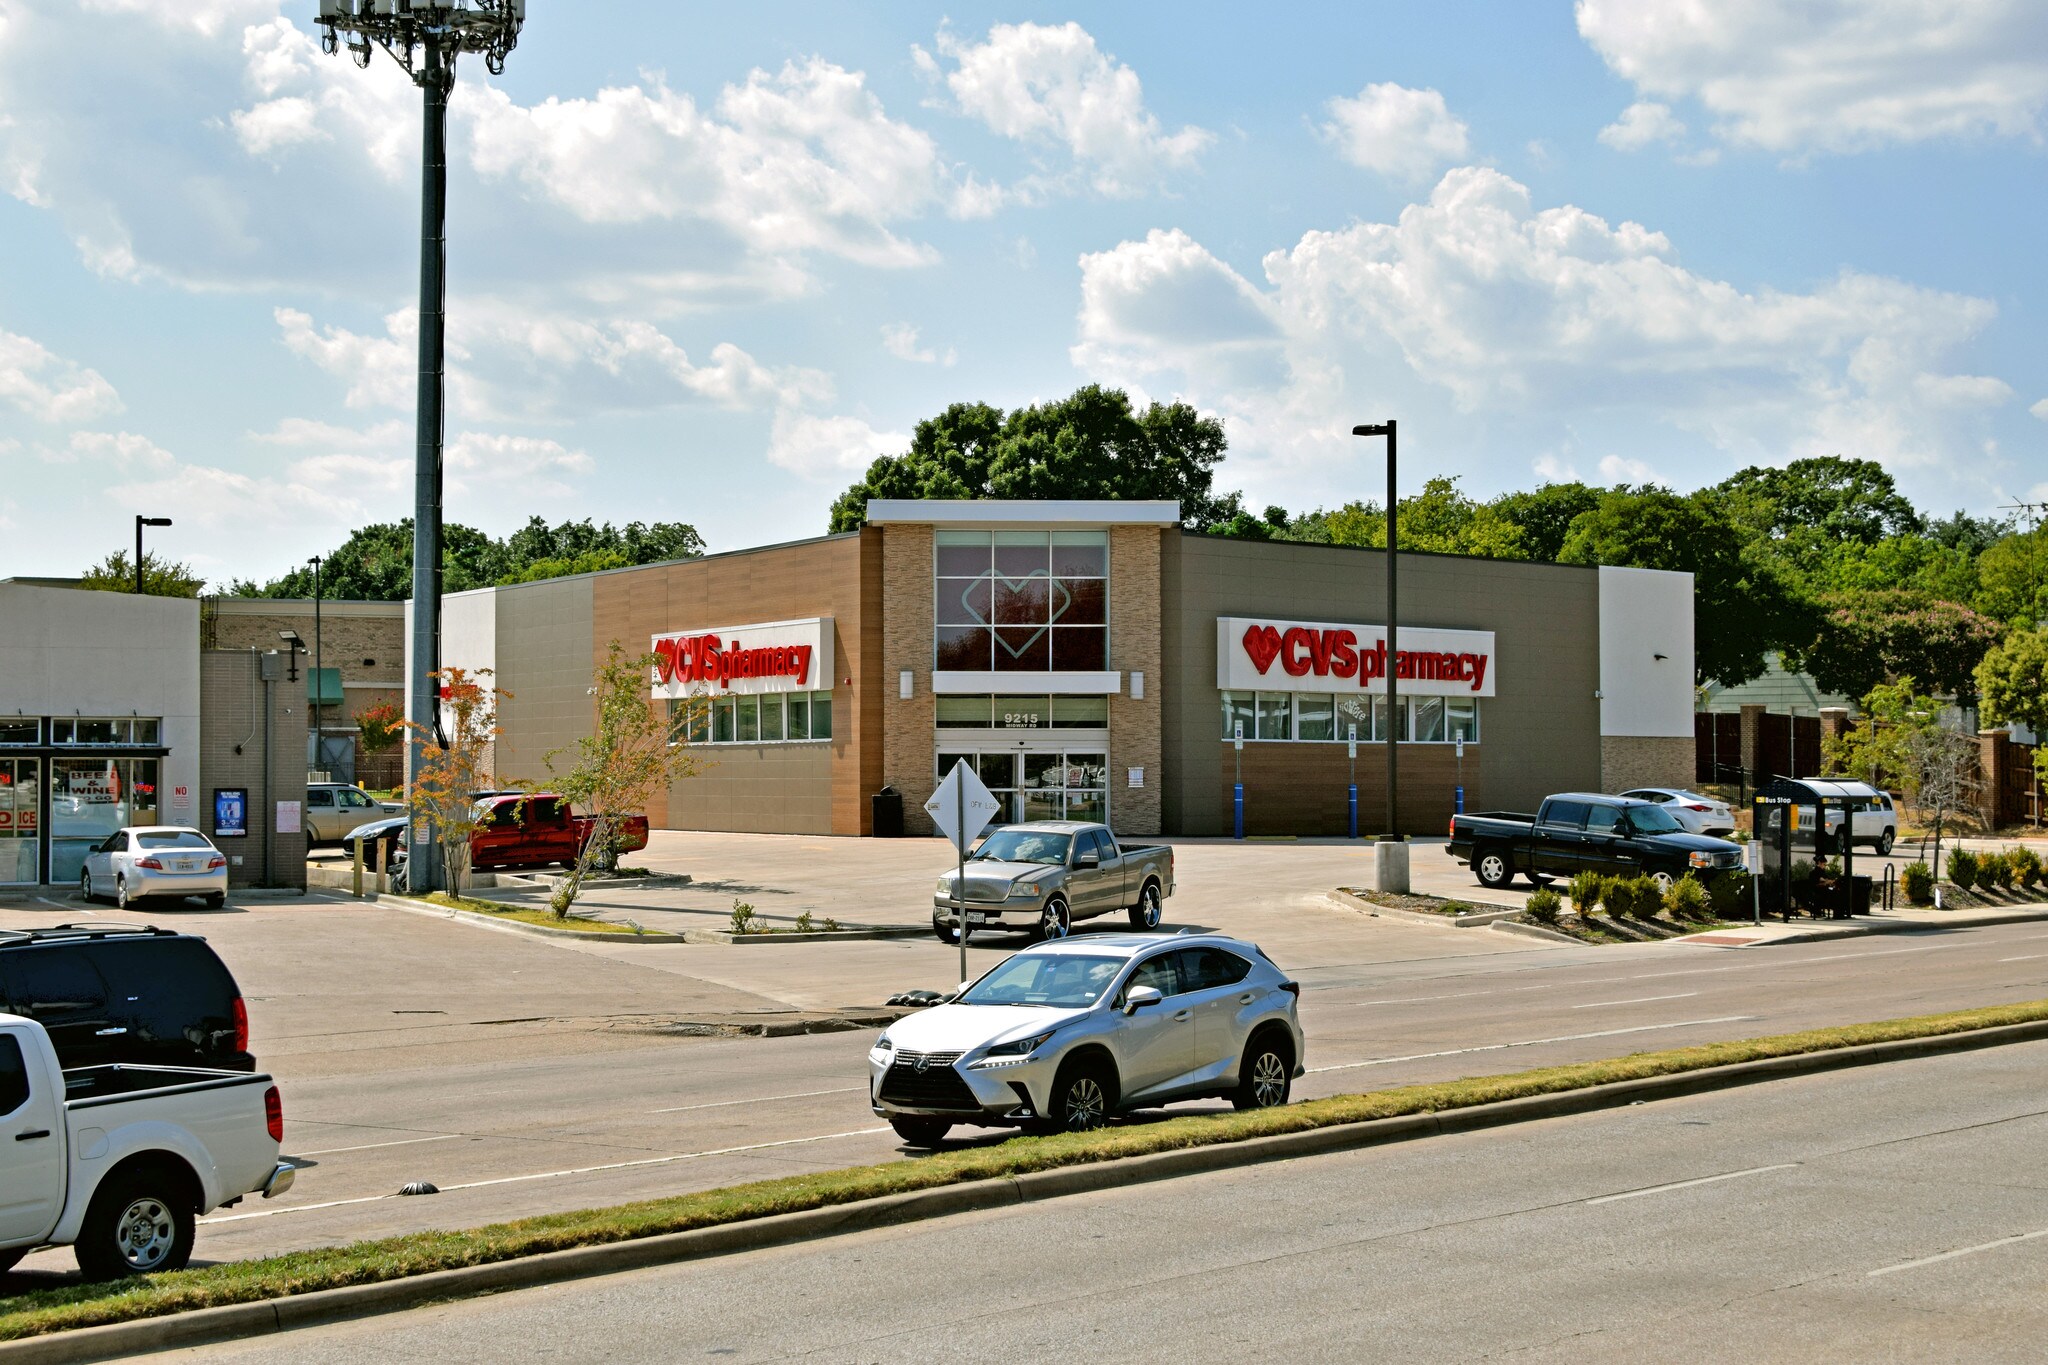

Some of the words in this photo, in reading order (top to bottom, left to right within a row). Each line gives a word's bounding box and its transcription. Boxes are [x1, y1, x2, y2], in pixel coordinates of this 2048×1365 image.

[674, 634, 721, 683] CVS
[721, 640, 812, 688] pharmacy
[1281, 627, 1358, 678] CVS
[1360, 639, 1488, 690] pharmacy
[1004, 713, 1038, 723] 9215
[71, 786, 115, 795] WINE
[175, 786, 188, 796] NO
[18, 811, 36, 824] ICE
